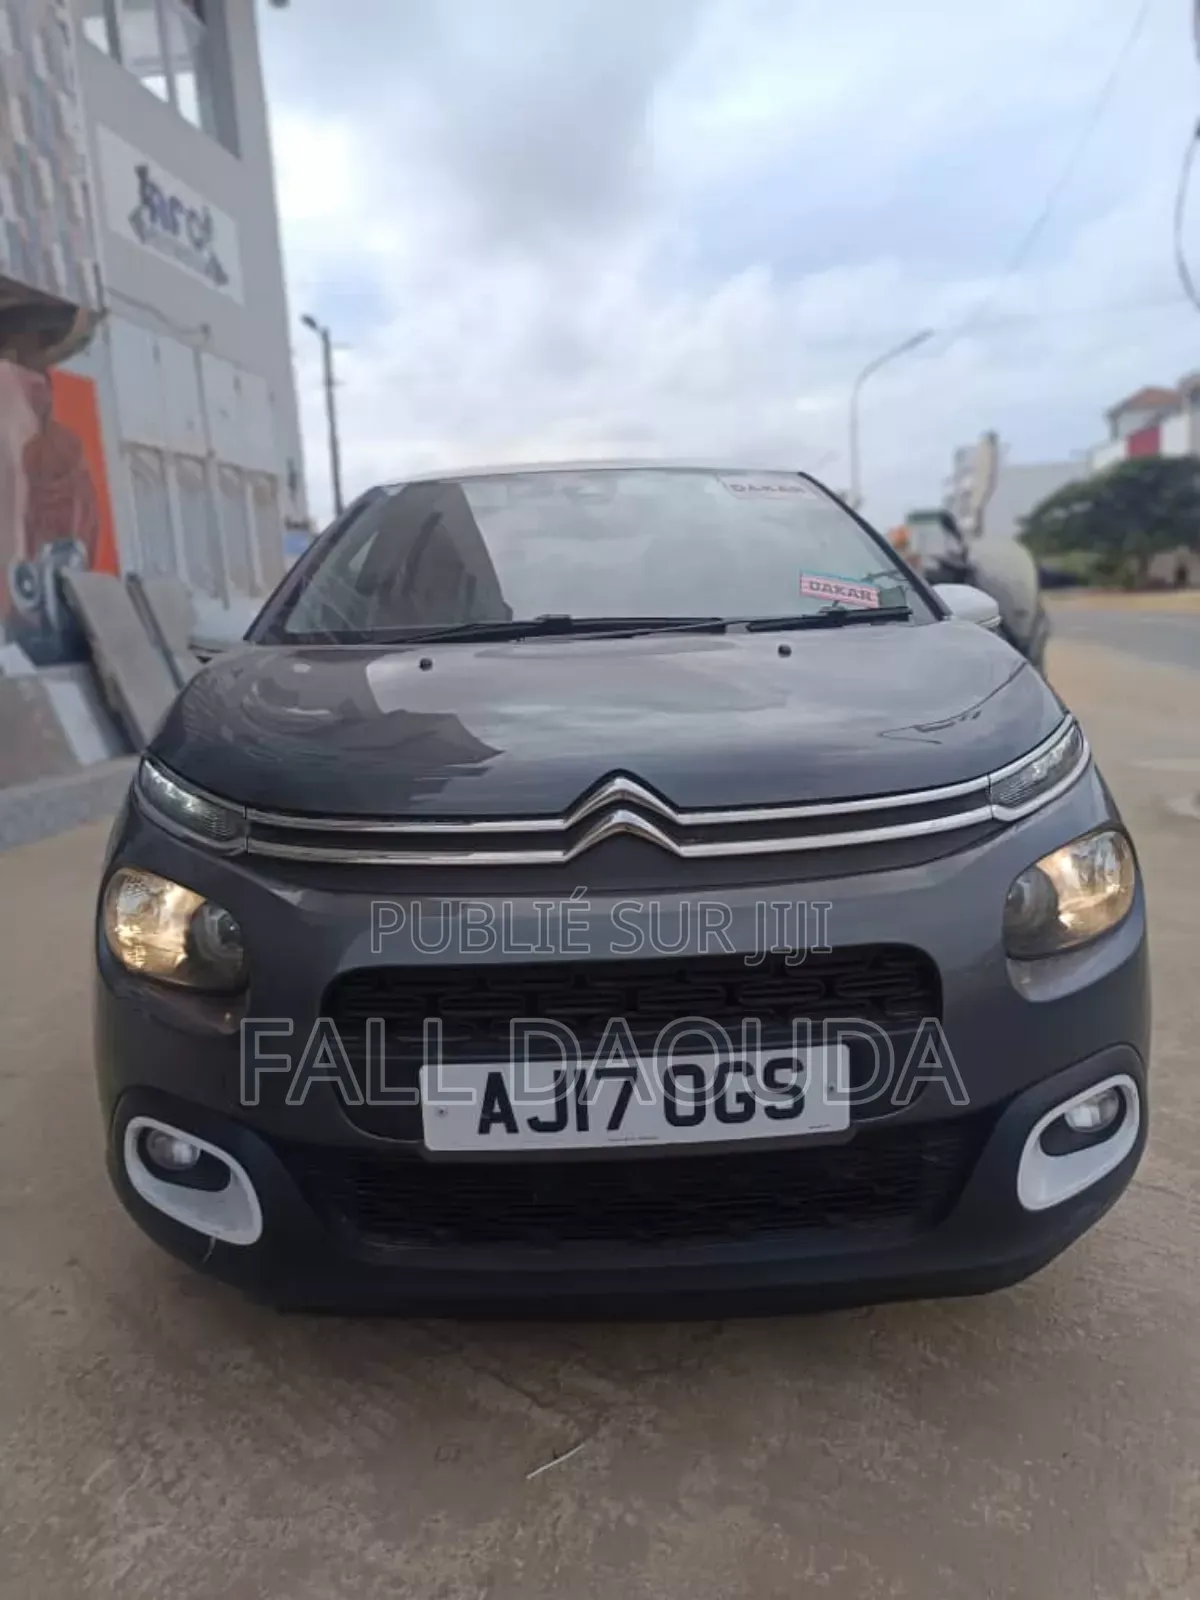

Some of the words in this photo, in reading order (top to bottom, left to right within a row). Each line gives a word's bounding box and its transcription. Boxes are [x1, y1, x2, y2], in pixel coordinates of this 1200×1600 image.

[808, 580, 873, 602] DAKAR
[477, 1065, 638, 1135] AJ17
[663, 1057, 806, 1128] OGS
